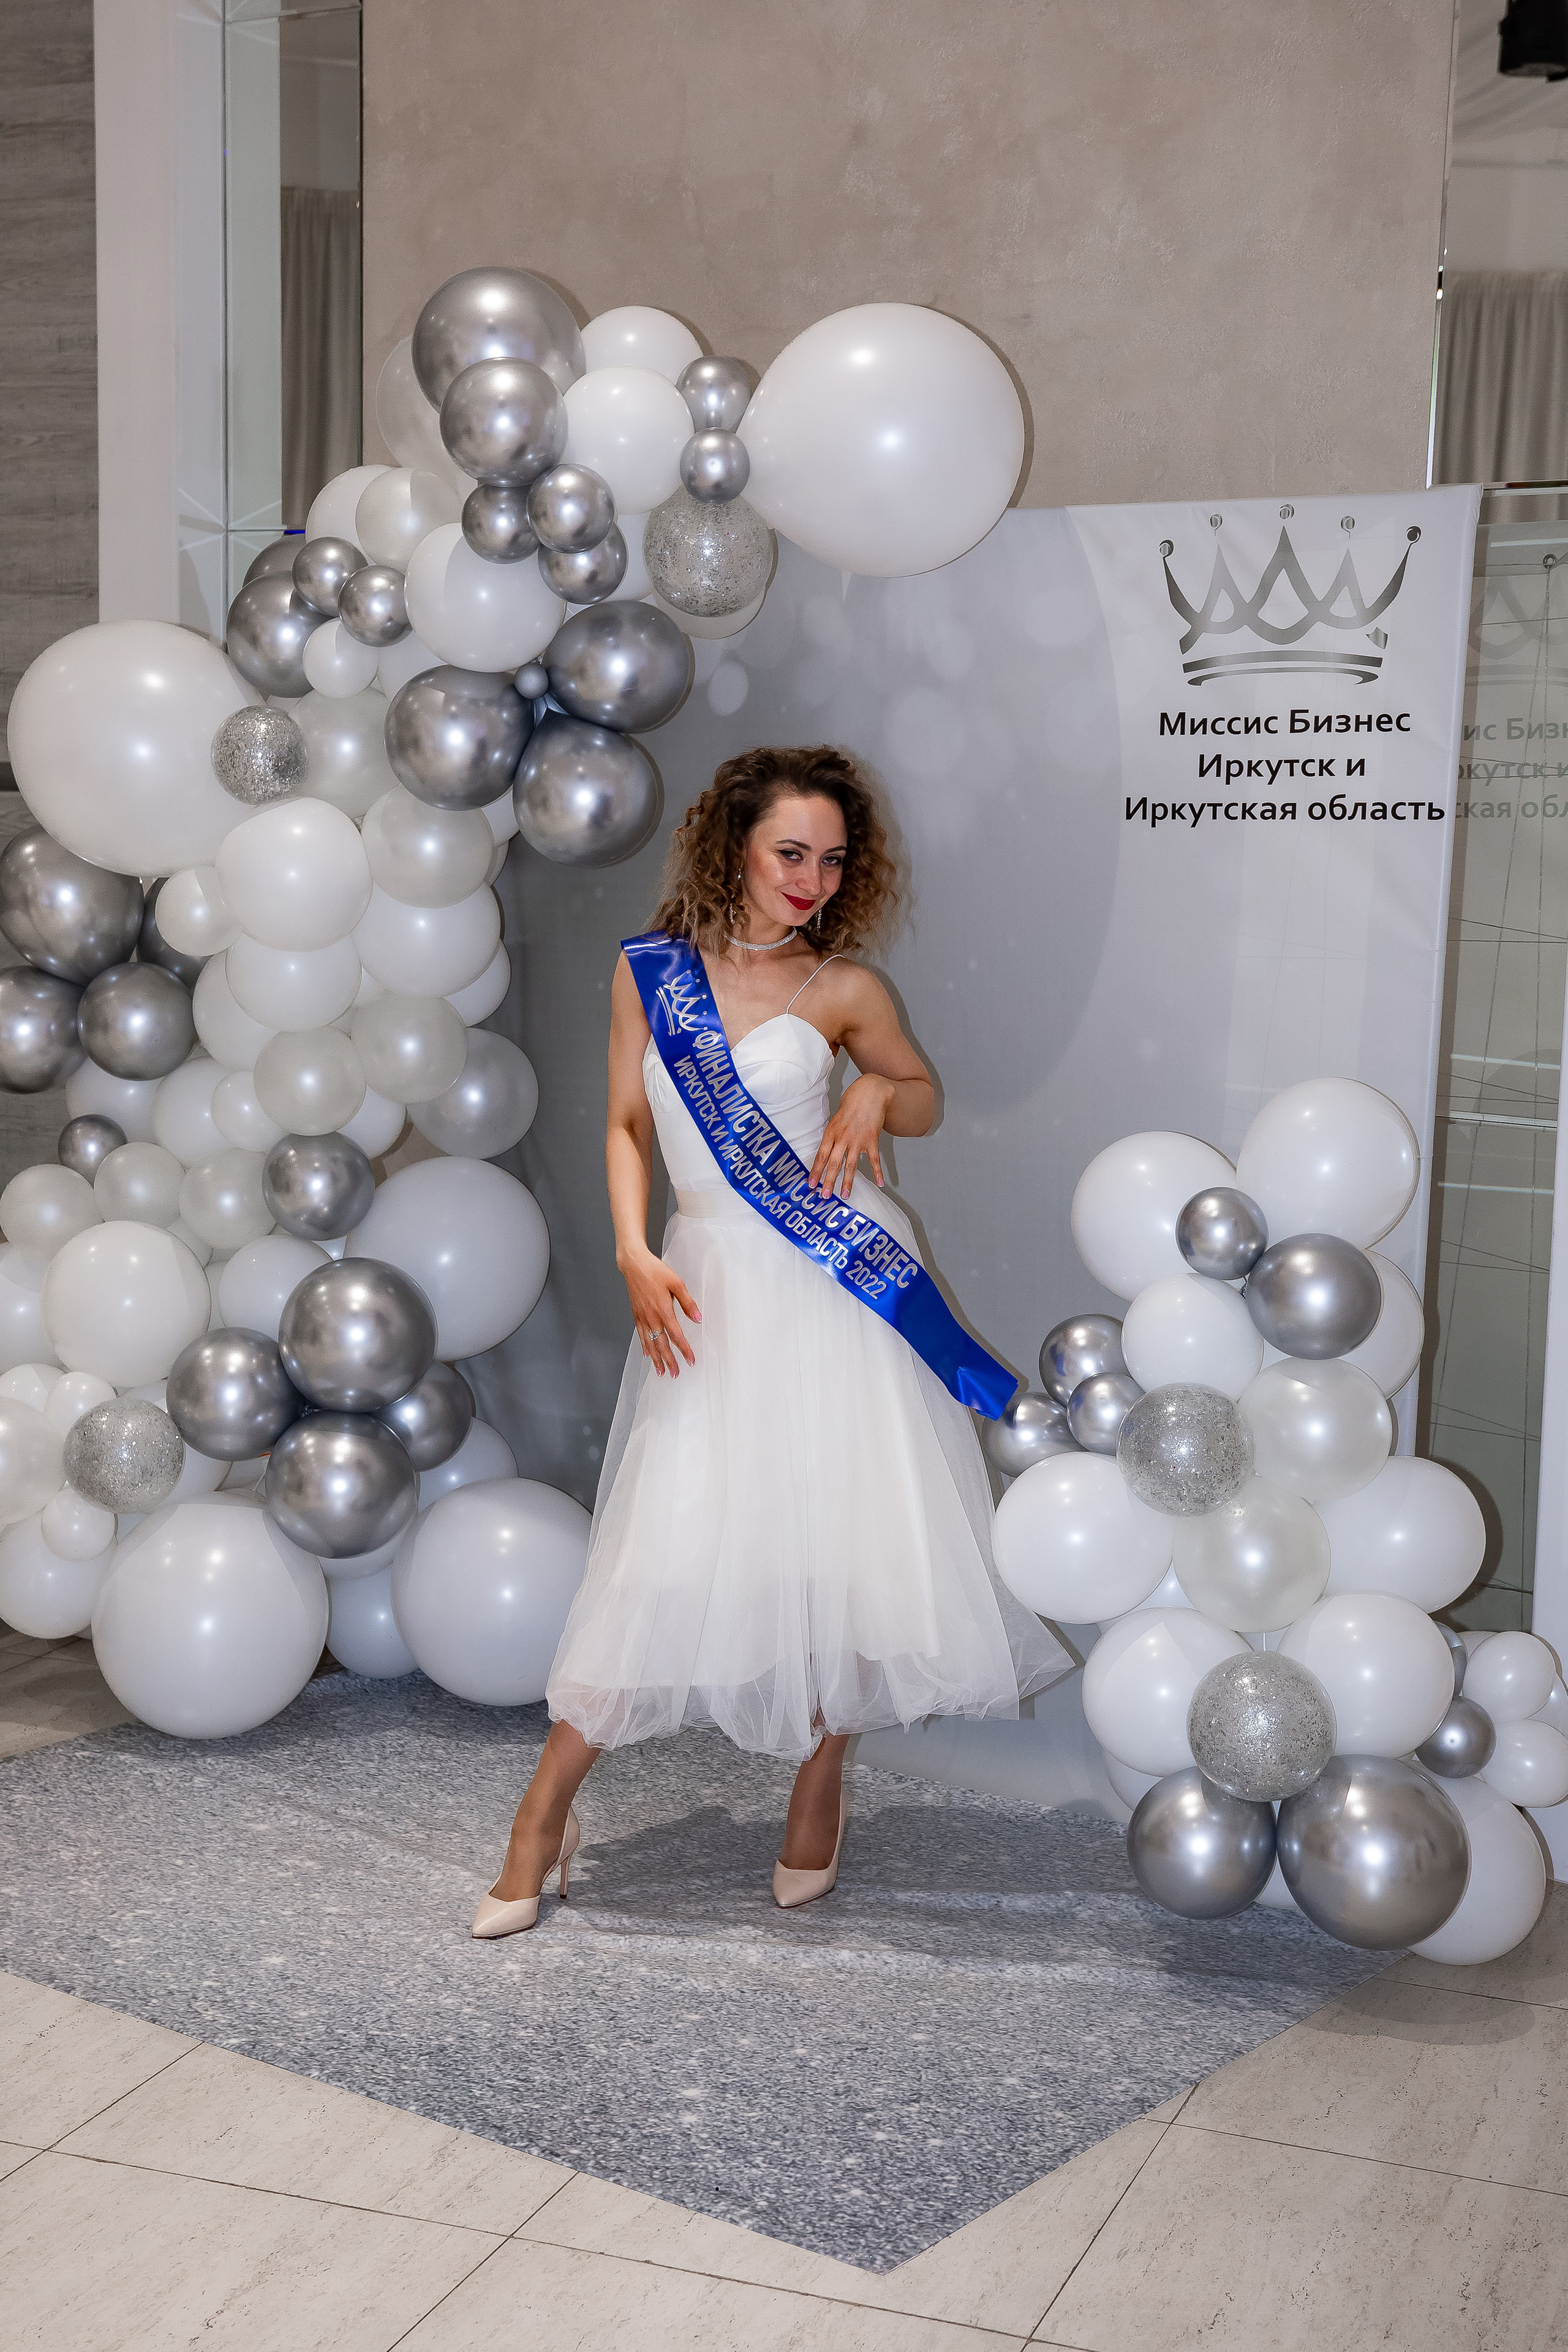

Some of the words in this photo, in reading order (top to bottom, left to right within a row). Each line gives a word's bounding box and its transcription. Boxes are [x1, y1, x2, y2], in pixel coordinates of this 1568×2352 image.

[1159, 712, 1278, 736] Миссис
[1289, 709, 1411, 734] Бизнес
[1463, 724, 1498, 741] ис
[1198, 753, 1336, 785] Иркутск
[1346, 758, 1365, 777] и
[1125, 797, 1297, 828] Иркутская
[1308, 793, 1445, 821] область
[674, 1055, 722, 1129] ИРКУТСК
[710, 1124, 729, 1143] И
[693, 1030, 782, 1166] ФИНАЛИСТКА
[766, 1151, 850, 1228] МИССИС
[839, 1214, 918, 1289] БИЗНЕС
[718, 1139, 792, 1219] ИРКУТСКАЯ
[785, 1210, 850, 1270] ОБЛАСТЬ
[845, 1260, 887, 1300] 2022
